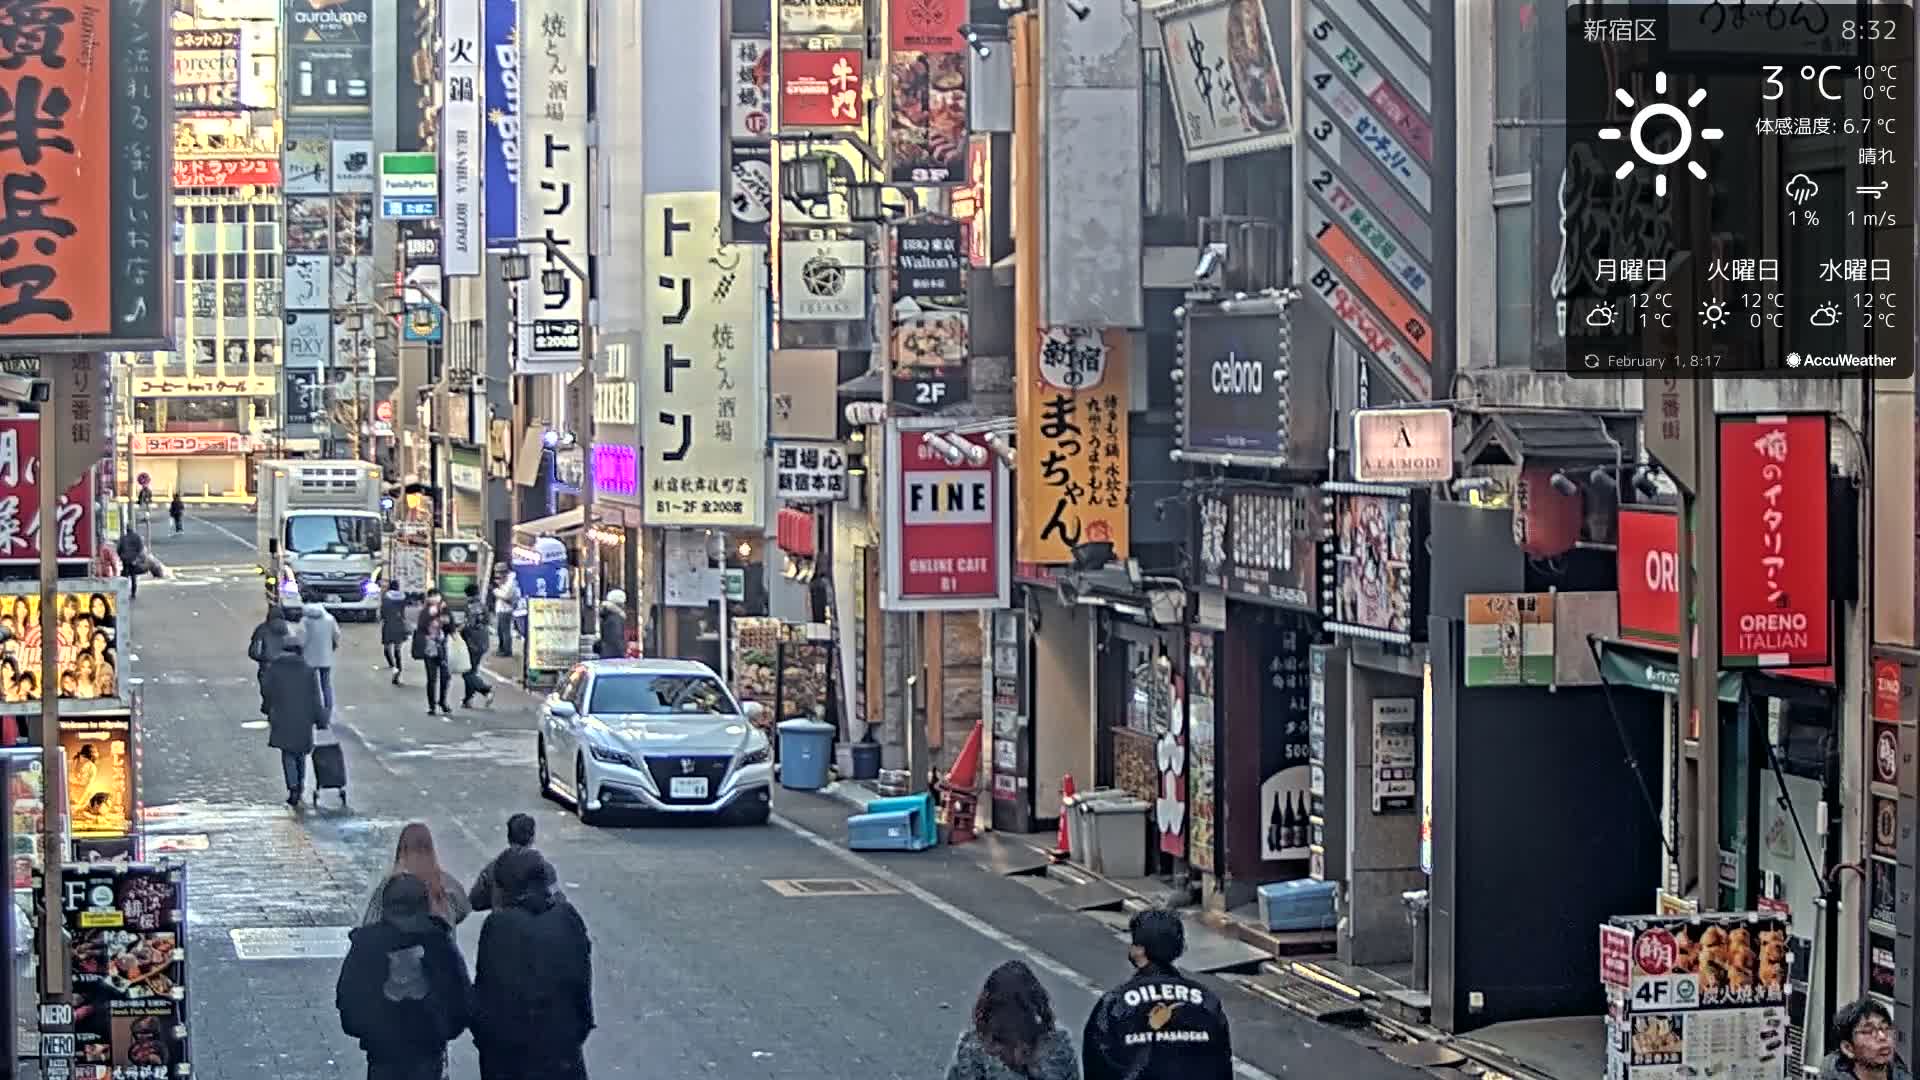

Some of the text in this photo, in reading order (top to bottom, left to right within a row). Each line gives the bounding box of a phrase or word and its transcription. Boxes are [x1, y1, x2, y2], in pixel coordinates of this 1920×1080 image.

[295, 11, 368, 24] auralume
[1313, 20, 1334, 41] 5
[449, 38, 474, 102] 火鍋
[541, 12, 569, 122] 焼とん酒場
[830, 56, 858, 120] 牛門
[1313, 73, 1333, 91] 4
[1313, 120, 1333, 141] 3
[1355, 116, 1411, 177] センチュリー
[1312, 170, 1333, 192] 2
[1316, 220, 1333, 239] 1
[1311, 267, 1340, 296] B1
[659, 207, 692, 462] トントン
[711, 322, 737, 442] 焼とん酒場
[1063, 371, 1084, 386] の
[1211, 351, 1263, 394] celona
[915, 382, 947, 403] 2F
[778, 448, 843, 469] 酒場心
[1040, 394, 1085, 548] まっちゃん
[910, 482, 986, 513] FINE
[1754, 428, 1790, 603] 俺のイタリアン
[909, 557, 988, 574] ONLINE CAFE
[1740, 613, 1808, 632] ORENO
[1739, 632, 1808, 650] ITALIAN
[1123, 984, 1204, 1006] OILERS
[1635, 981, 1669, 1004] 4F
[40, 1004, 72, 1025] NERO
[42, 1034, 74, 1055] NERO
